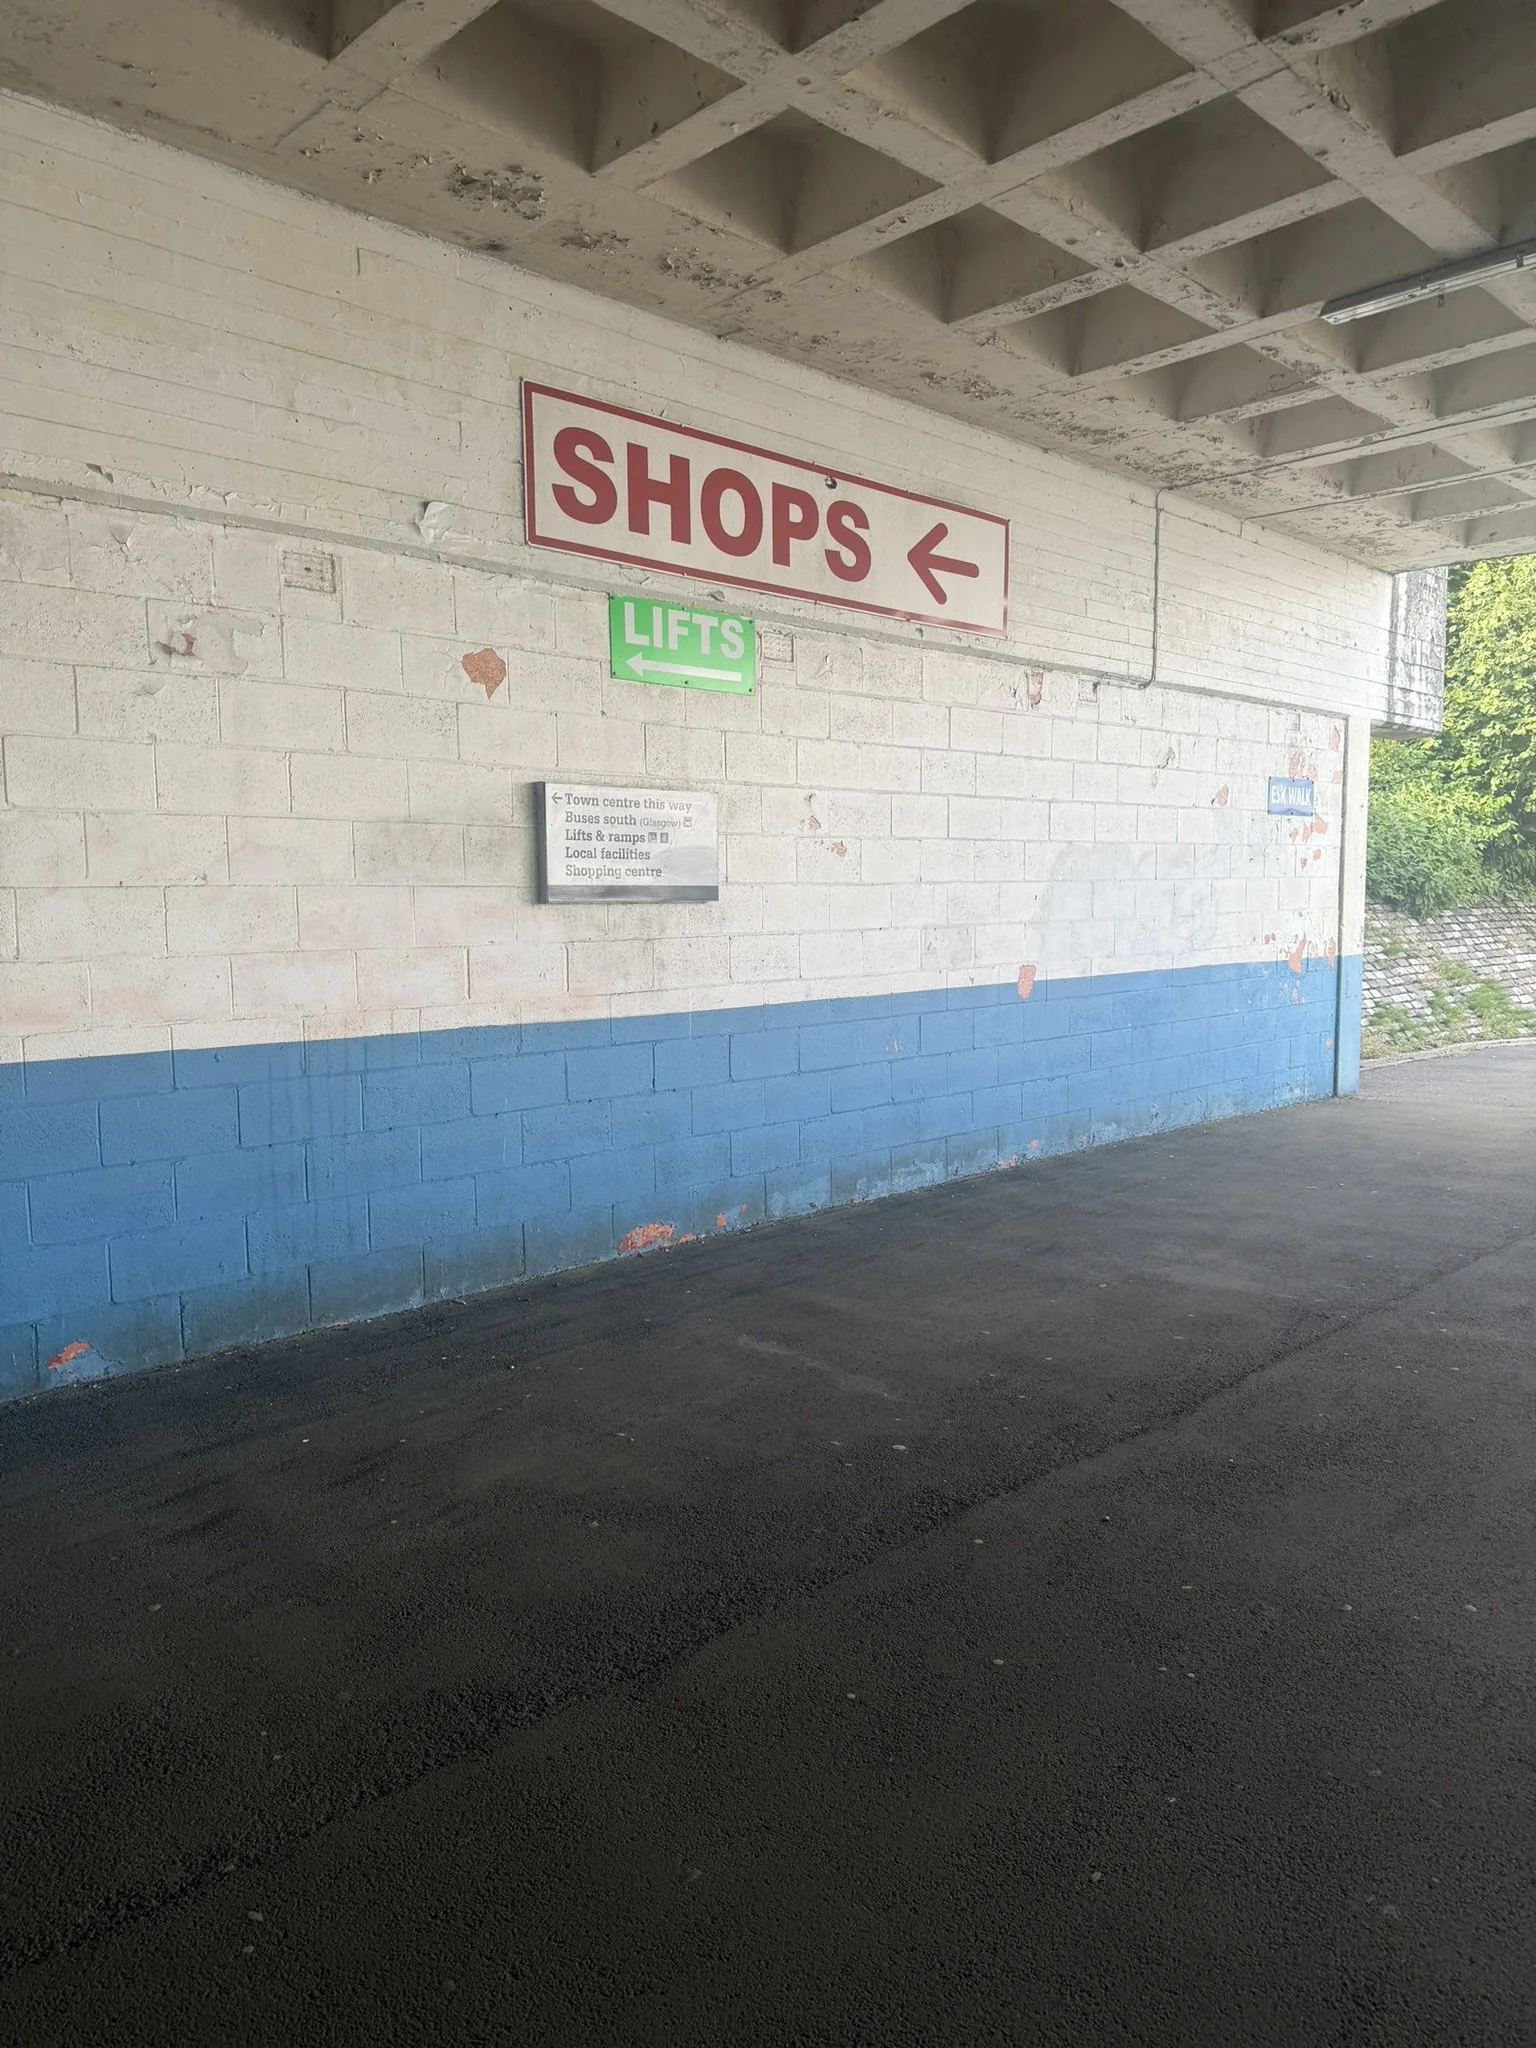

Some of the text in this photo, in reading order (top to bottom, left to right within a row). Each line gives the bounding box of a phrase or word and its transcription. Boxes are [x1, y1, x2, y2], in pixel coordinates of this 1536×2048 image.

[551, 426, 872, 582] SHOPS
[623, 602, 745, 660] LIFTS
[565, 793, 692, 814] Town centre this way
[1271, 785, 1312, 806] ESK WALK
[565, 811, 681, 829] Buses south (Glasgow)
[565, 829, 646, 845] Lifts & ramps
[565, 847, 650, 860] Local facilities
[565, 865, 662, 879] Shopping centre
